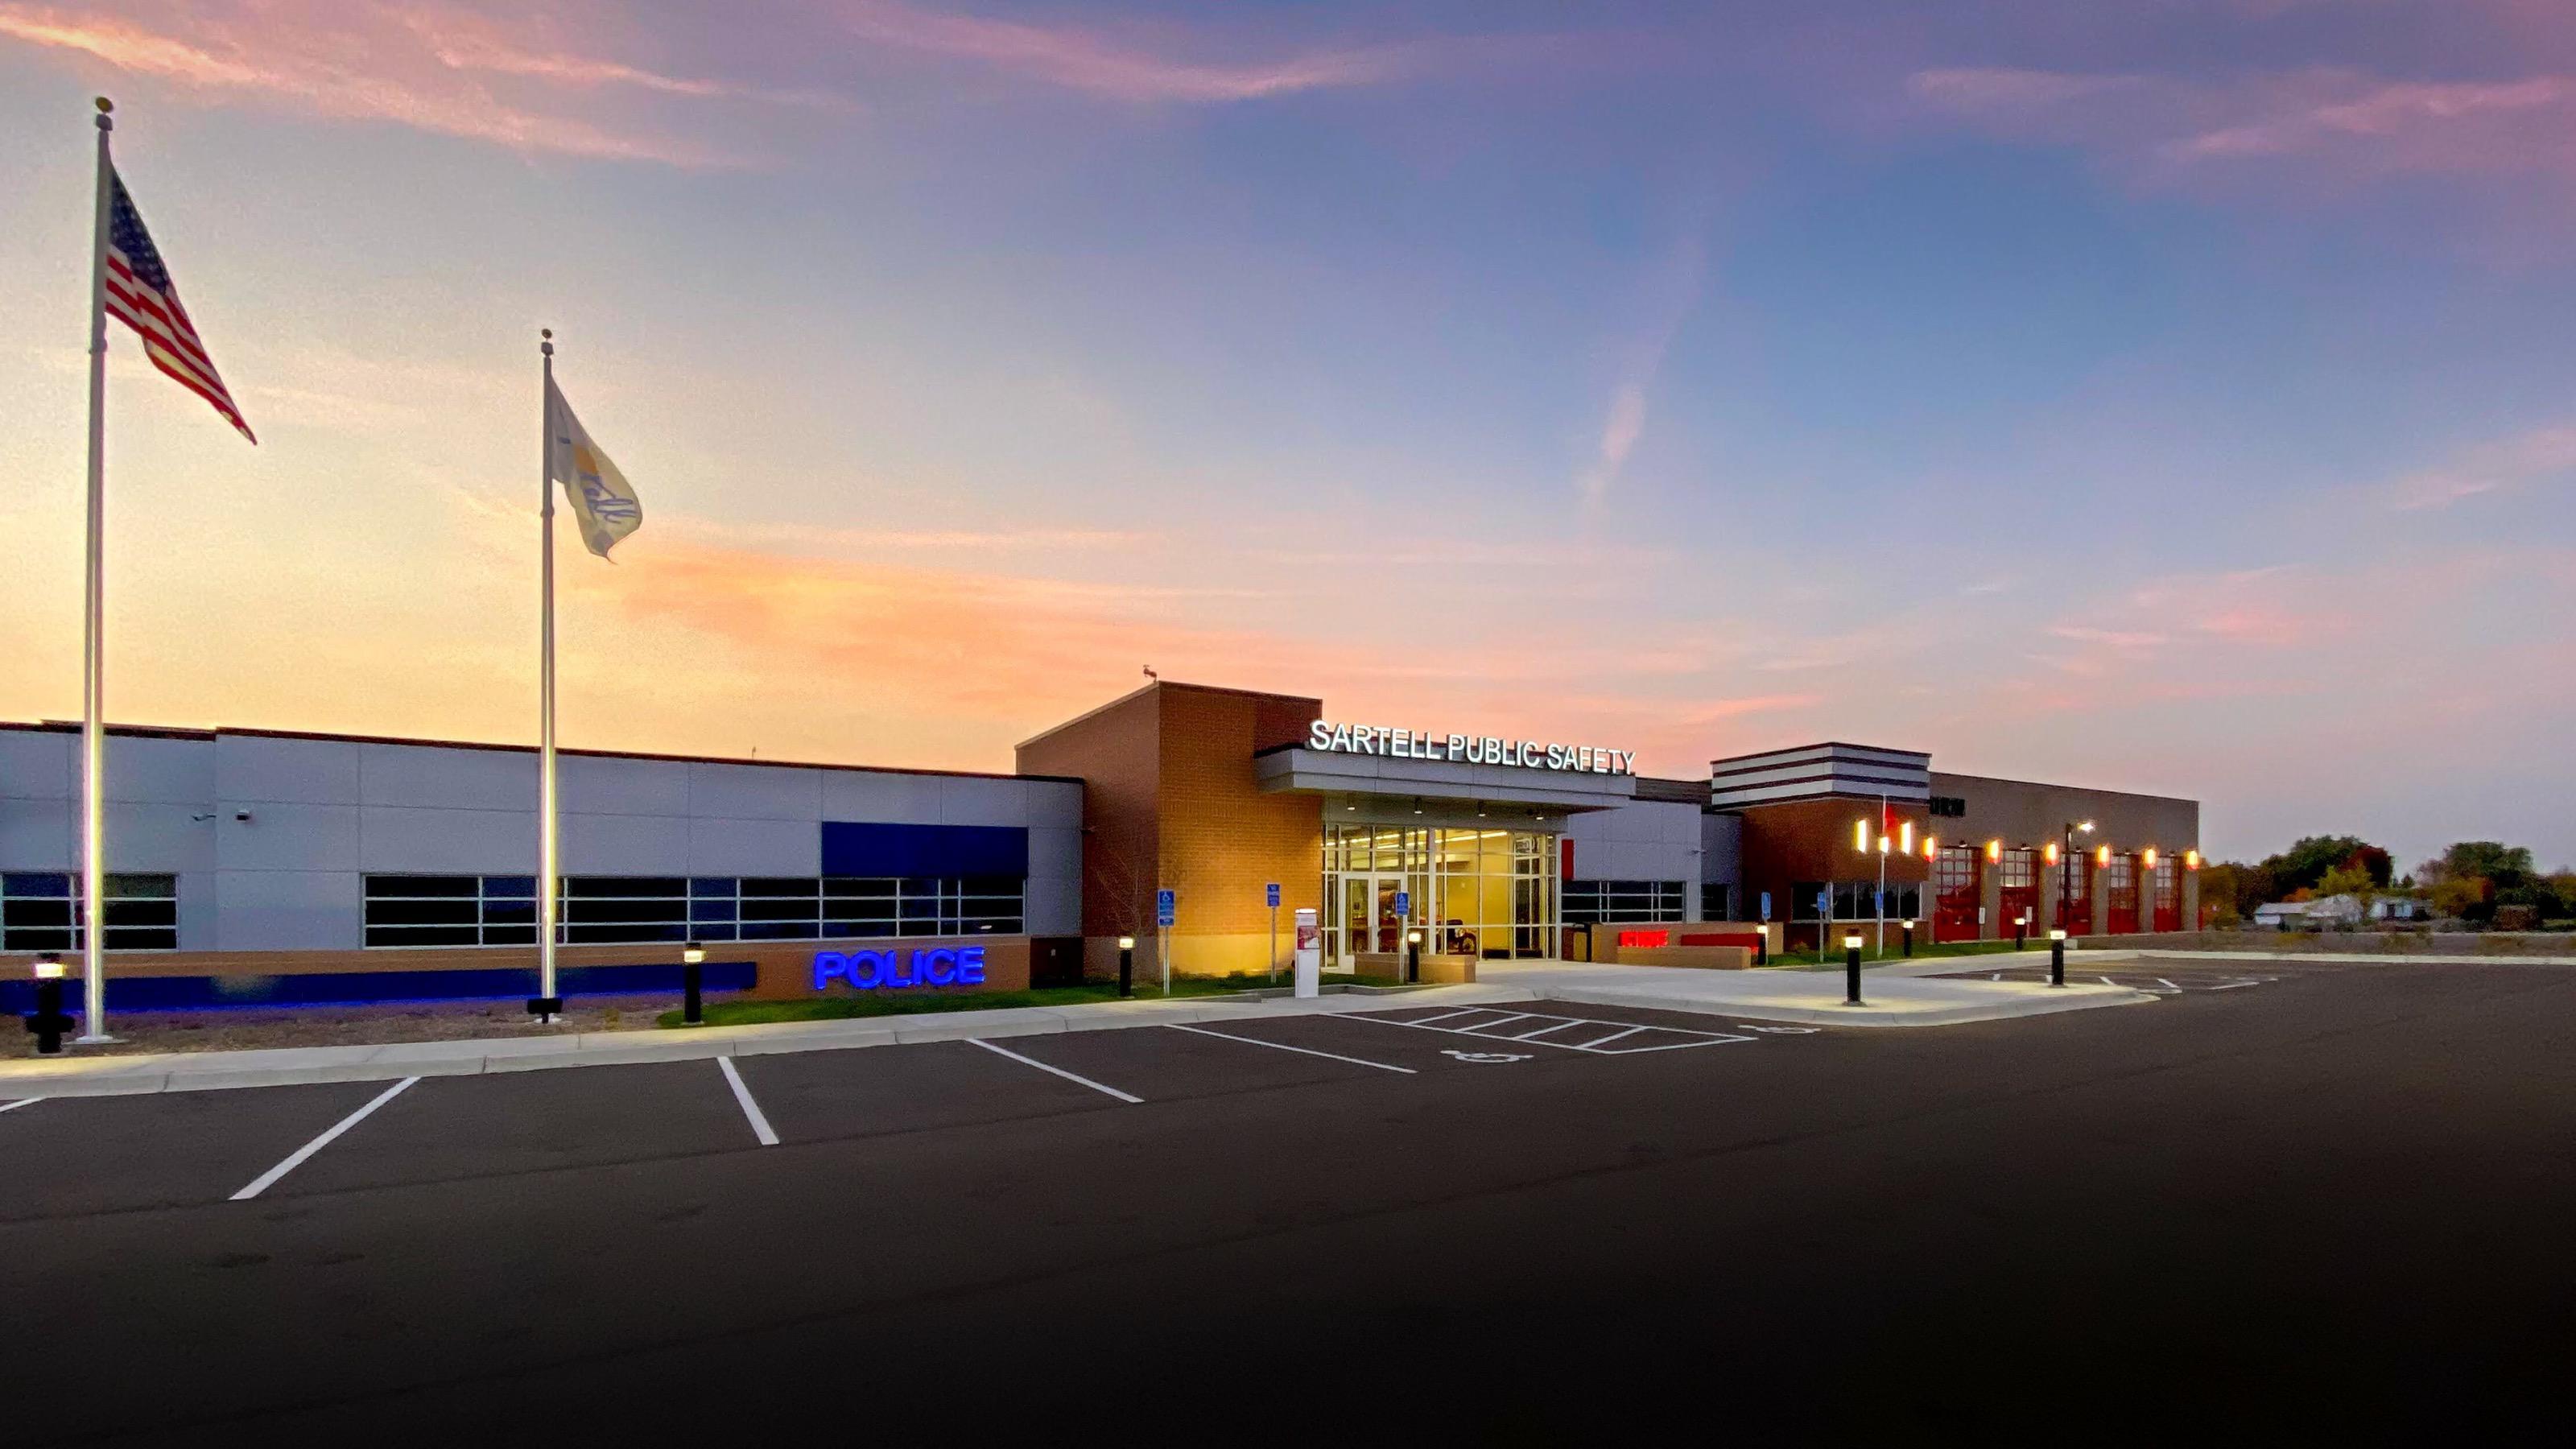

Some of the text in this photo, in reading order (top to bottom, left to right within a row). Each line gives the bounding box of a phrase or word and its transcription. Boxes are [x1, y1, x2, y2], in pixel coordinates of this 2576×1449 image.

[1310, 719, 1637, 775] SARTELL PUBLIC SAFETY
[813, 946, 985, 989] POLICE
